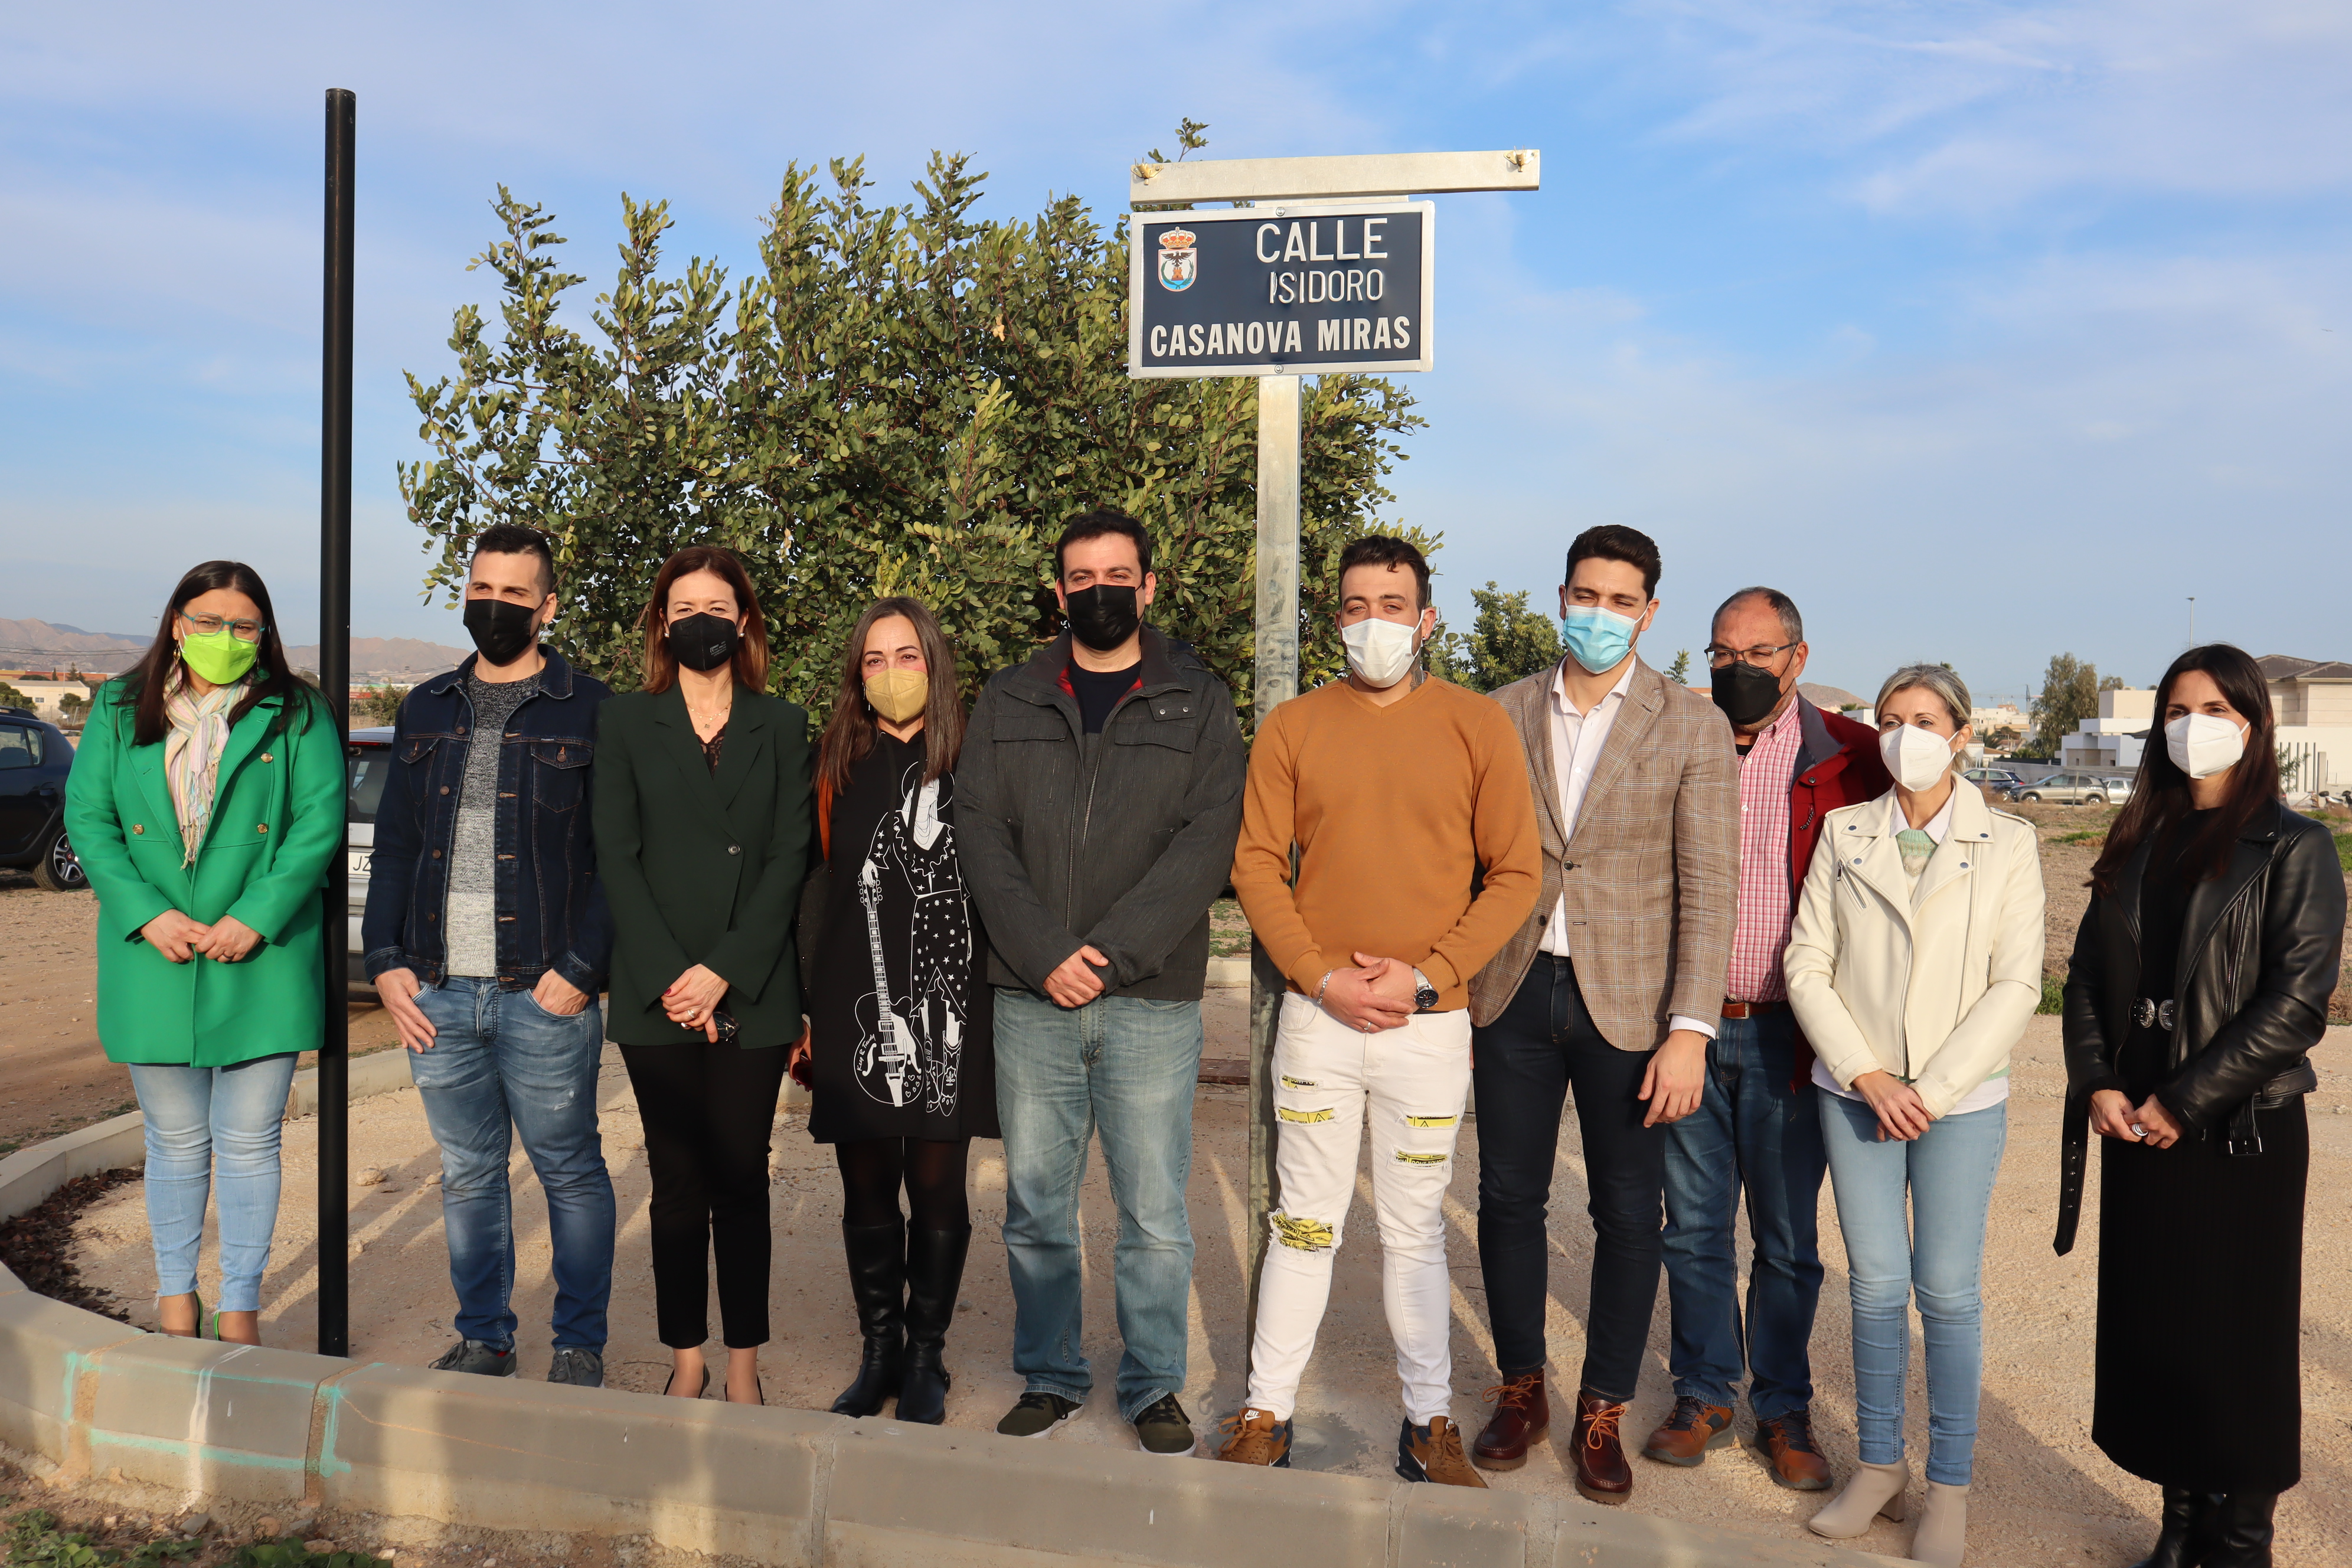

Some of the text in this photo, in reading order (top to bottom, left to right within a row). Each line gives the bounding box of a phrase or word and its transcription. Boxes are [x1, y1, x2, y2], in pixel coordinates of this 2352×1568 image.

[1256, 217, 1388, 263] CALLE
[1269, 269, 1384, 304] ISIDORO
[1150, 320, 1302, 357] CASANOVA
[1317, 316, 1410, 352] MIRAS
